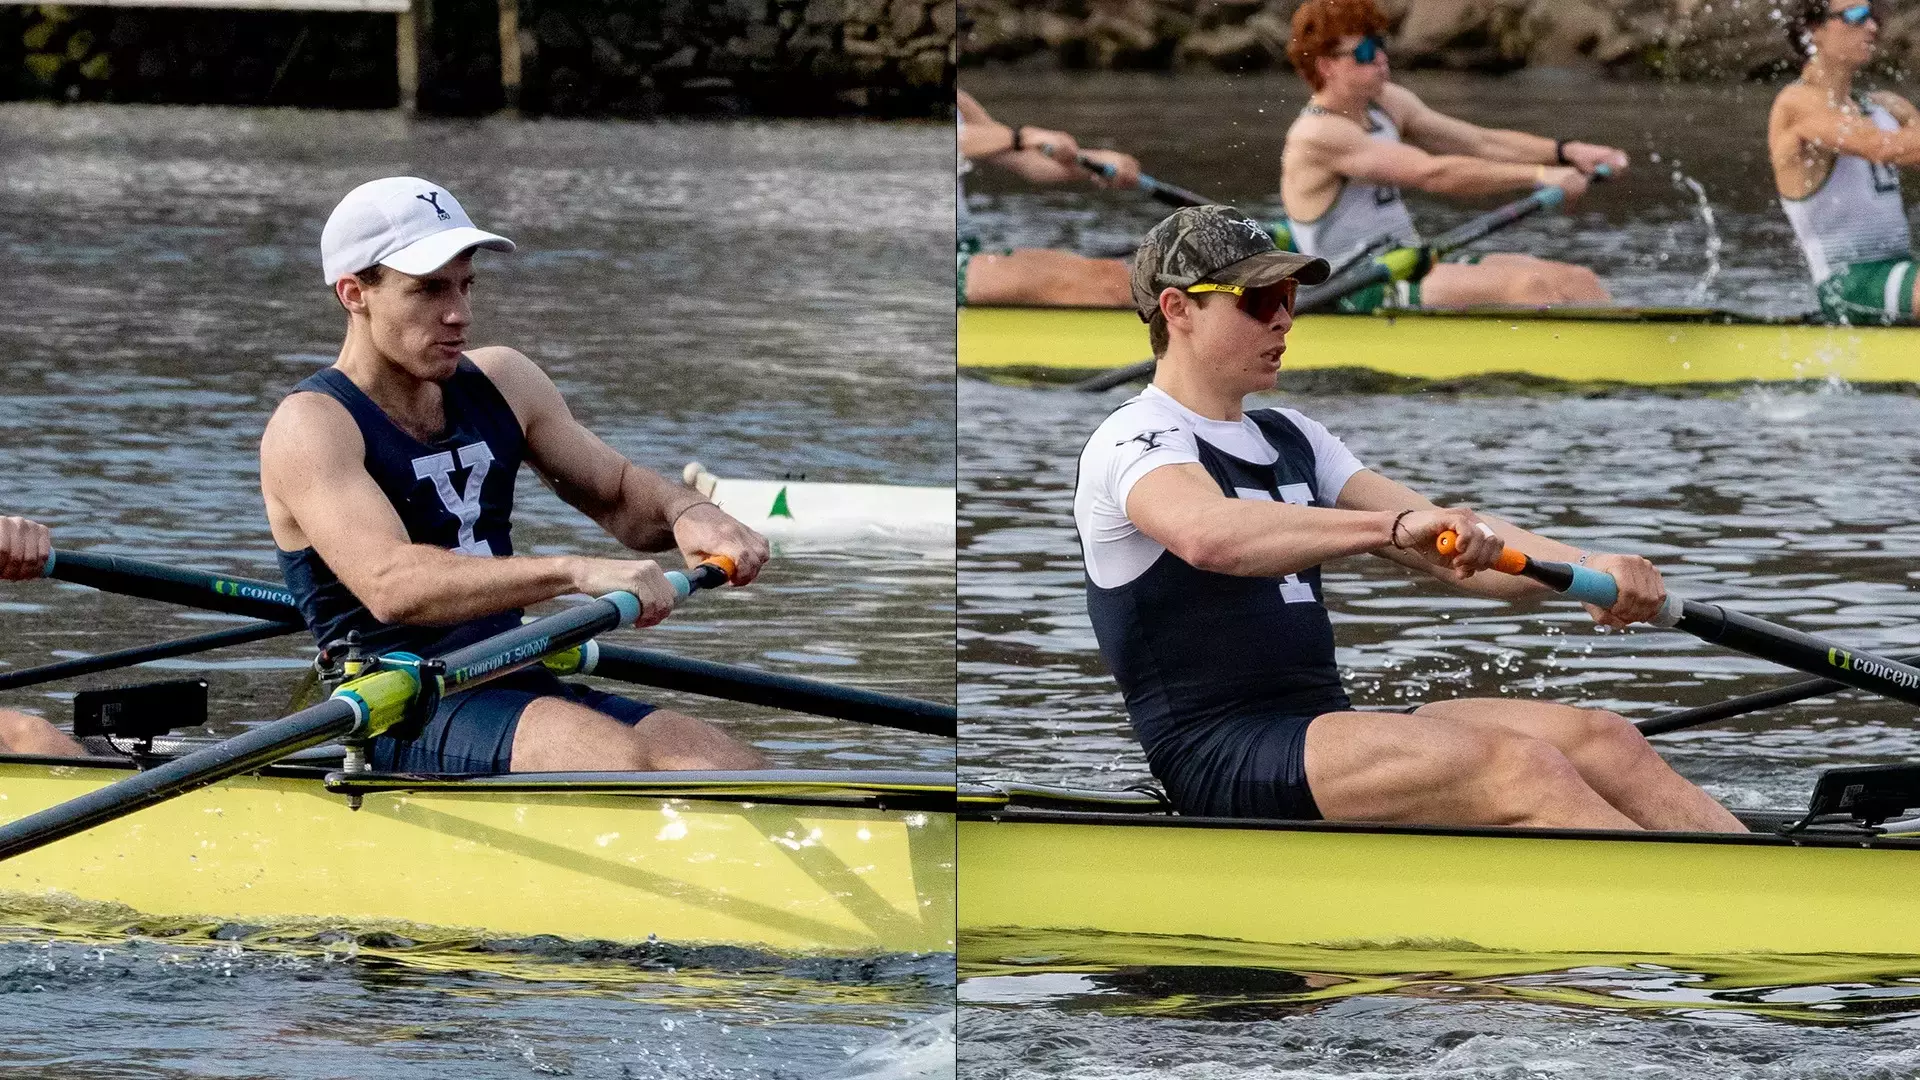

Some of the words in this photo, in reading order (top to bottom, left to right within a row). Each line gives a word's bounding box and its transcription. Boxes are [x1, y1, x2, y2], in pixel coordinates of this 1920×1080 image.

[416, 191, 446, 214] Y
[411, 441, 495, 556] Y
[241, 586, 296, 607] conce
[1853, 658, 1920, 689] concept
